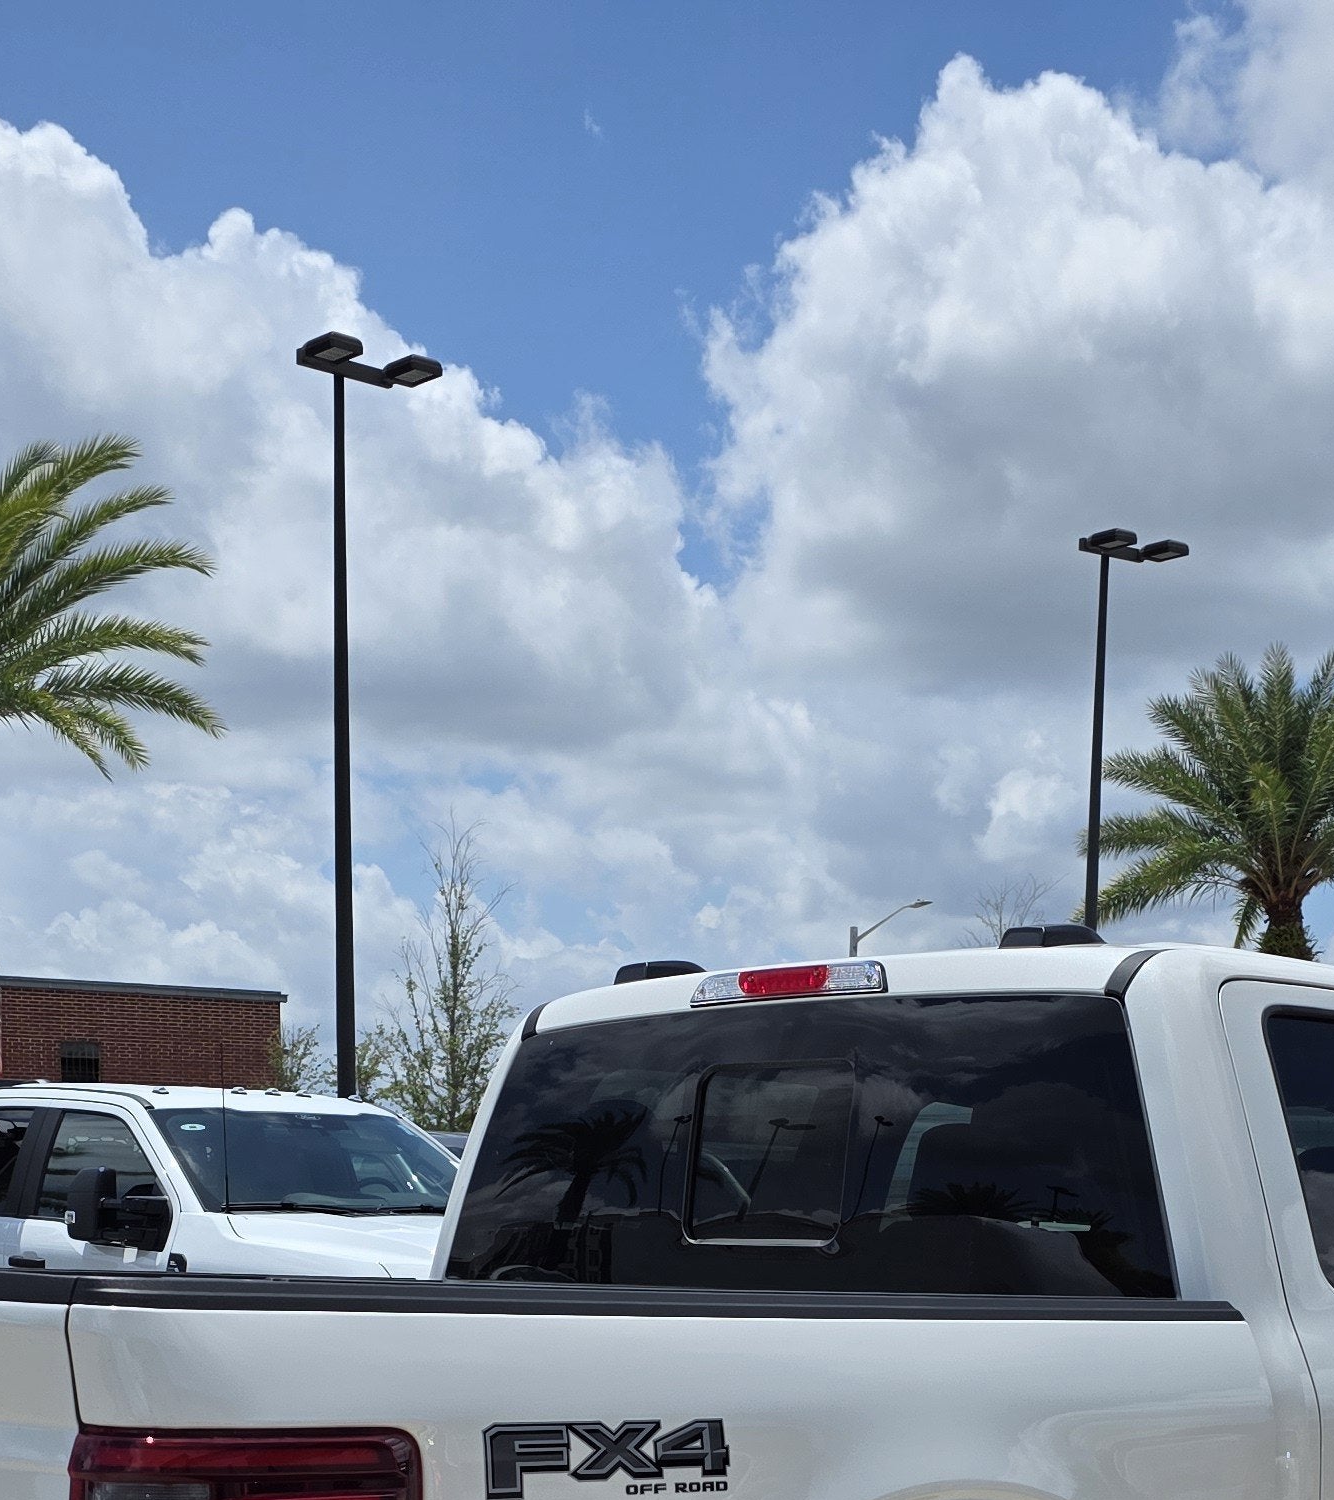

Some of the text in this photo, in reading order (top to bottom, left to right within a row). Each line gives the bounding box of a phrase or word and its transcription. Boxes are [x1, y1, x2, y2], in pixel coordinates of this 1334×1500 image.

[482, 1418, 729, 1500] FX4
[625, 1480, 728, 1495] OFF ROAD
